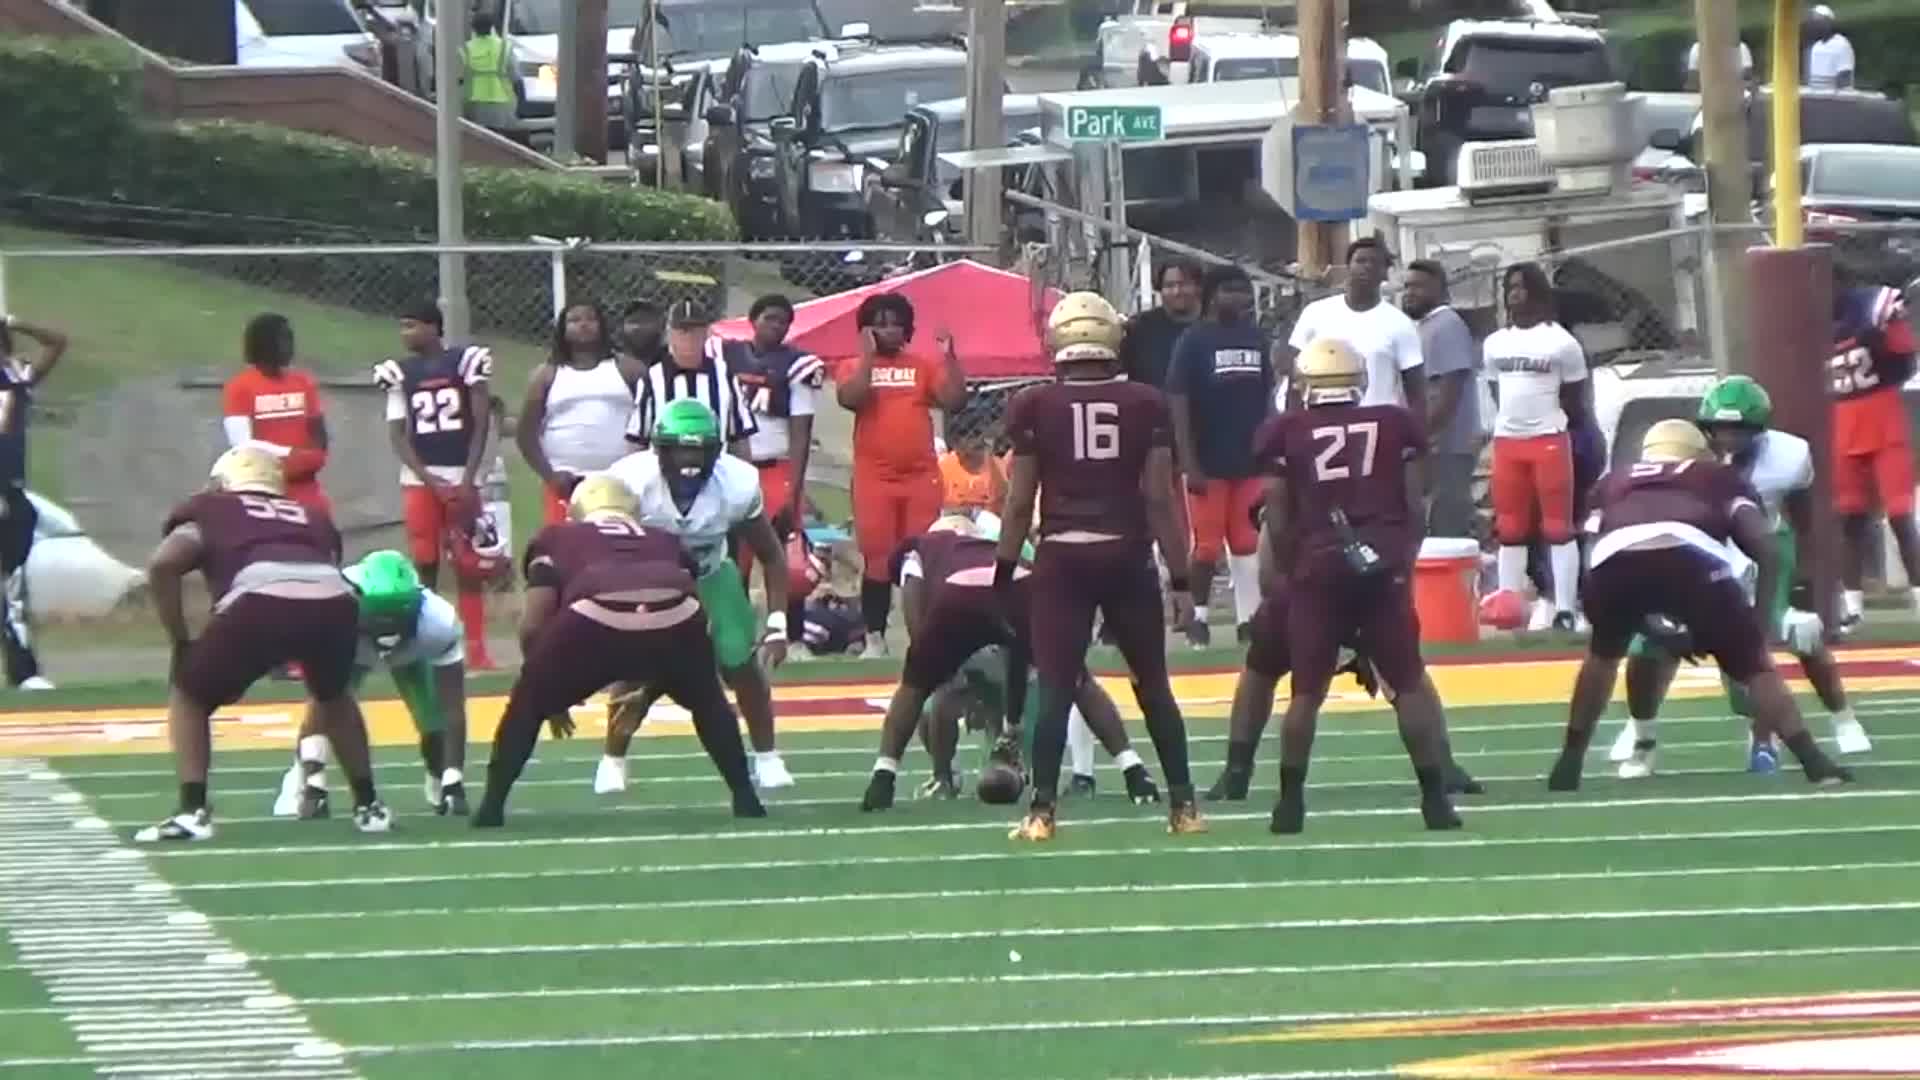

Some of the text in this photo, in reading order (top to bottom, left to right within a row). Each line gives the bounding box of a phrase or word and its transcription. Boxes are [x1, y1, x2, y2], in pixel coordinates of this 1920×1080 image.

[1072, 109, 1157, 136] Park AVE
[412, 388, 463, 434] 22
[1071, 402, 1120, 461] 16
[1312, 421, 1379, 481] 27
[240, 495, 309, 525] 55
